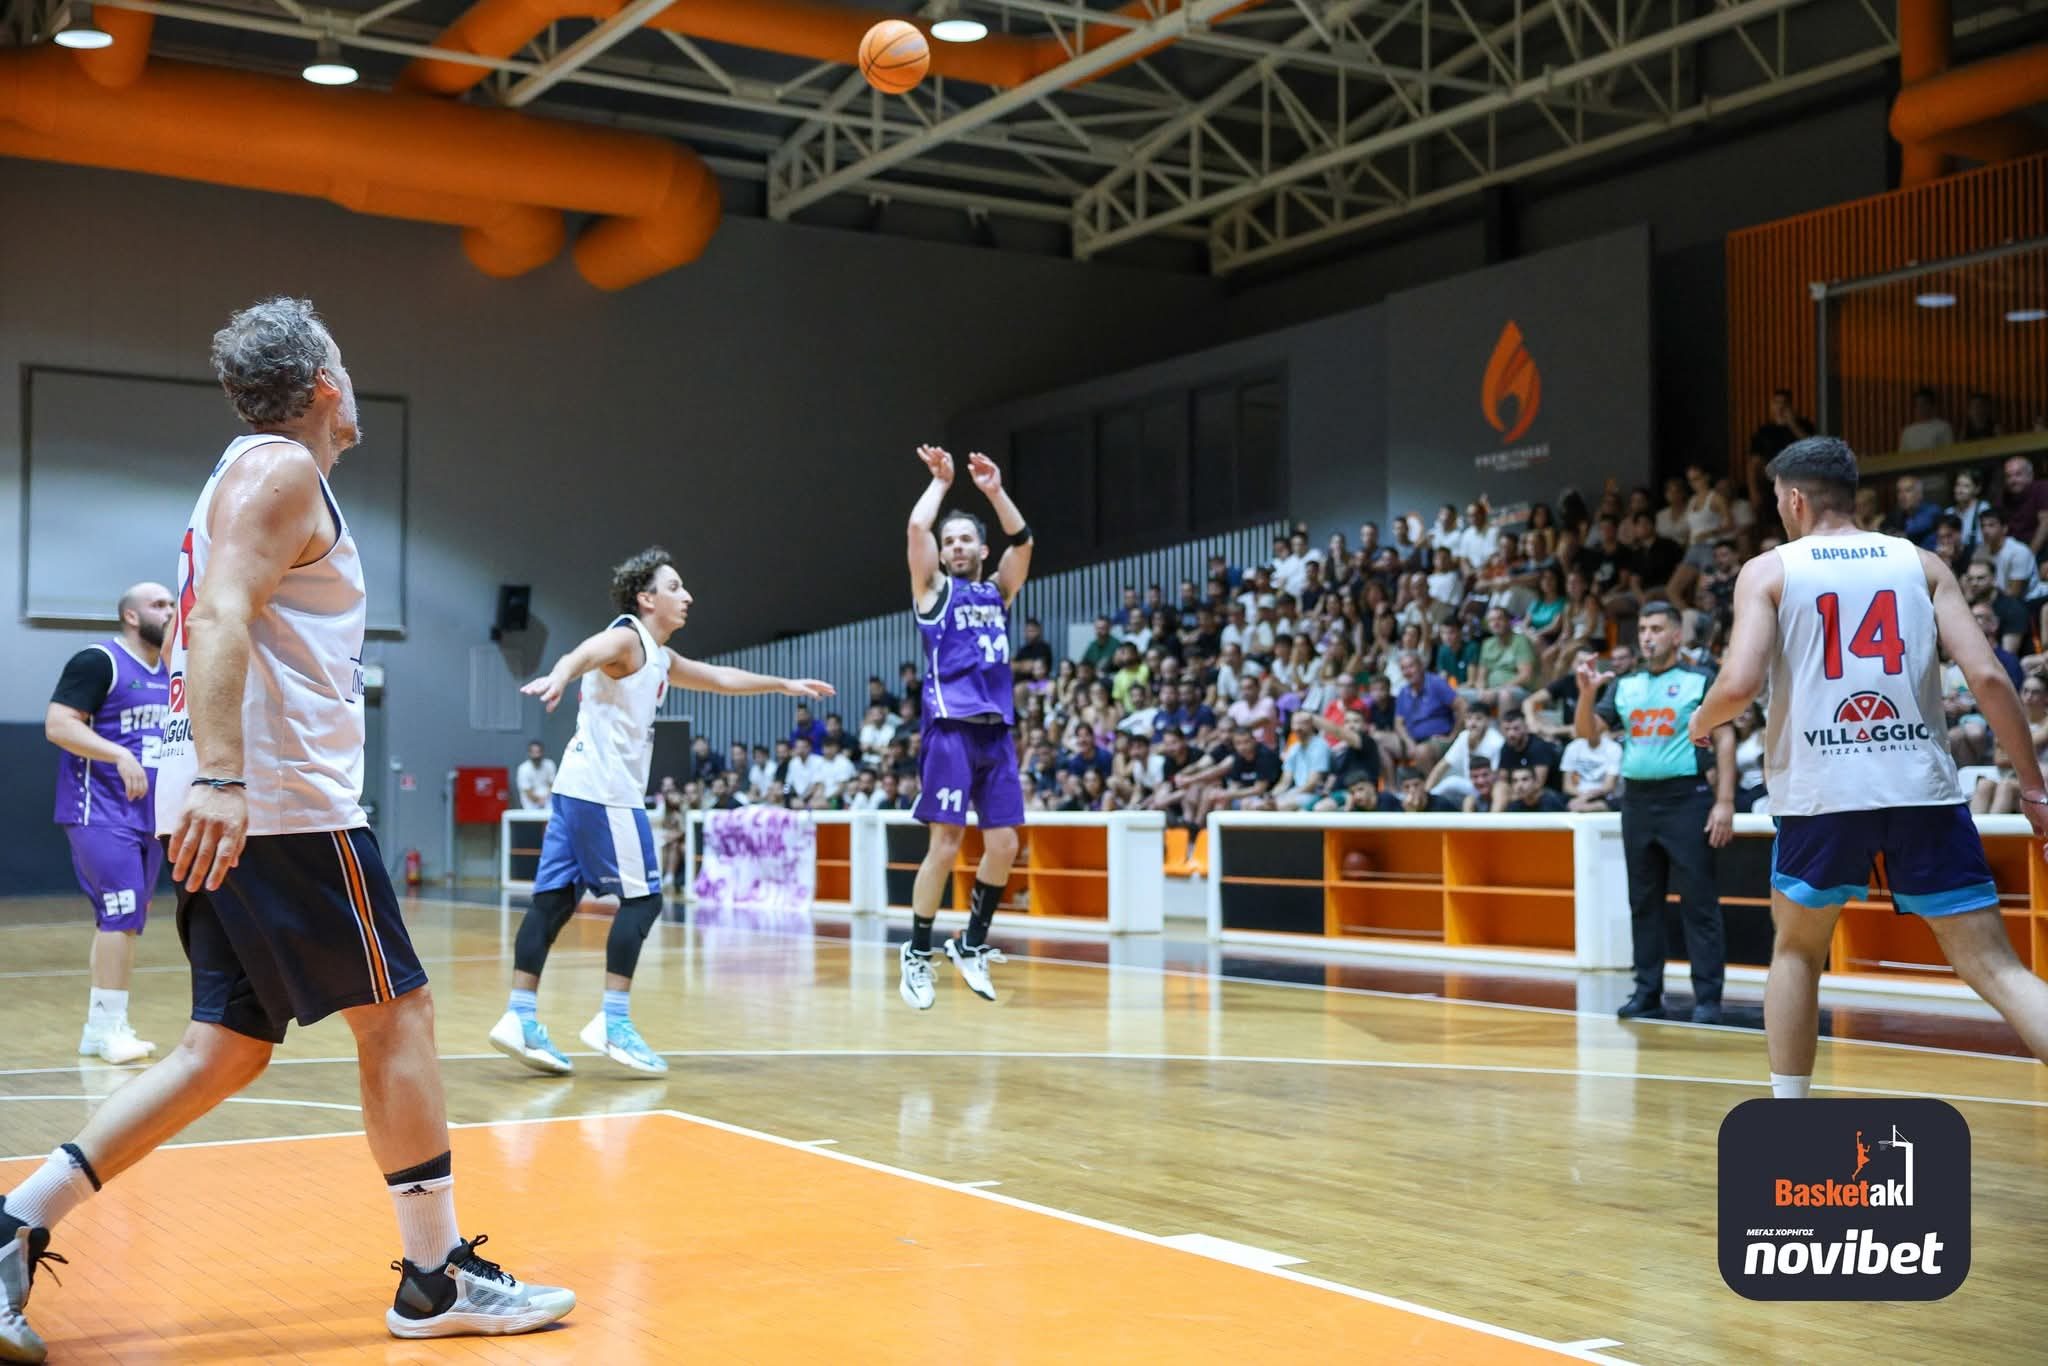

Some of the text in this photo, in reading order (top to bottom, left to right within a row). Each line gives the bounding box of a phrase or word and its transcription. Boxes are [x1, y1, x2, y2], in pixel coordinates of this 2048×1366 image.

[1811, 546, 1888, 560] ΒΑΡΒΑΡΑΣ
[1815, 589, 1905, 680] 14
[1630, 706, 1676, 737] 272
[1804, 723, 1930, 747] VILLAGGIO
[142, 735, 163, 769] 2
[1821, 747, 1860, 756] PIZZA
[1880, 744, 1918, 752] GRILL
[936, 787, 962, 812] 11
[103, 889, 137, 917] 29
